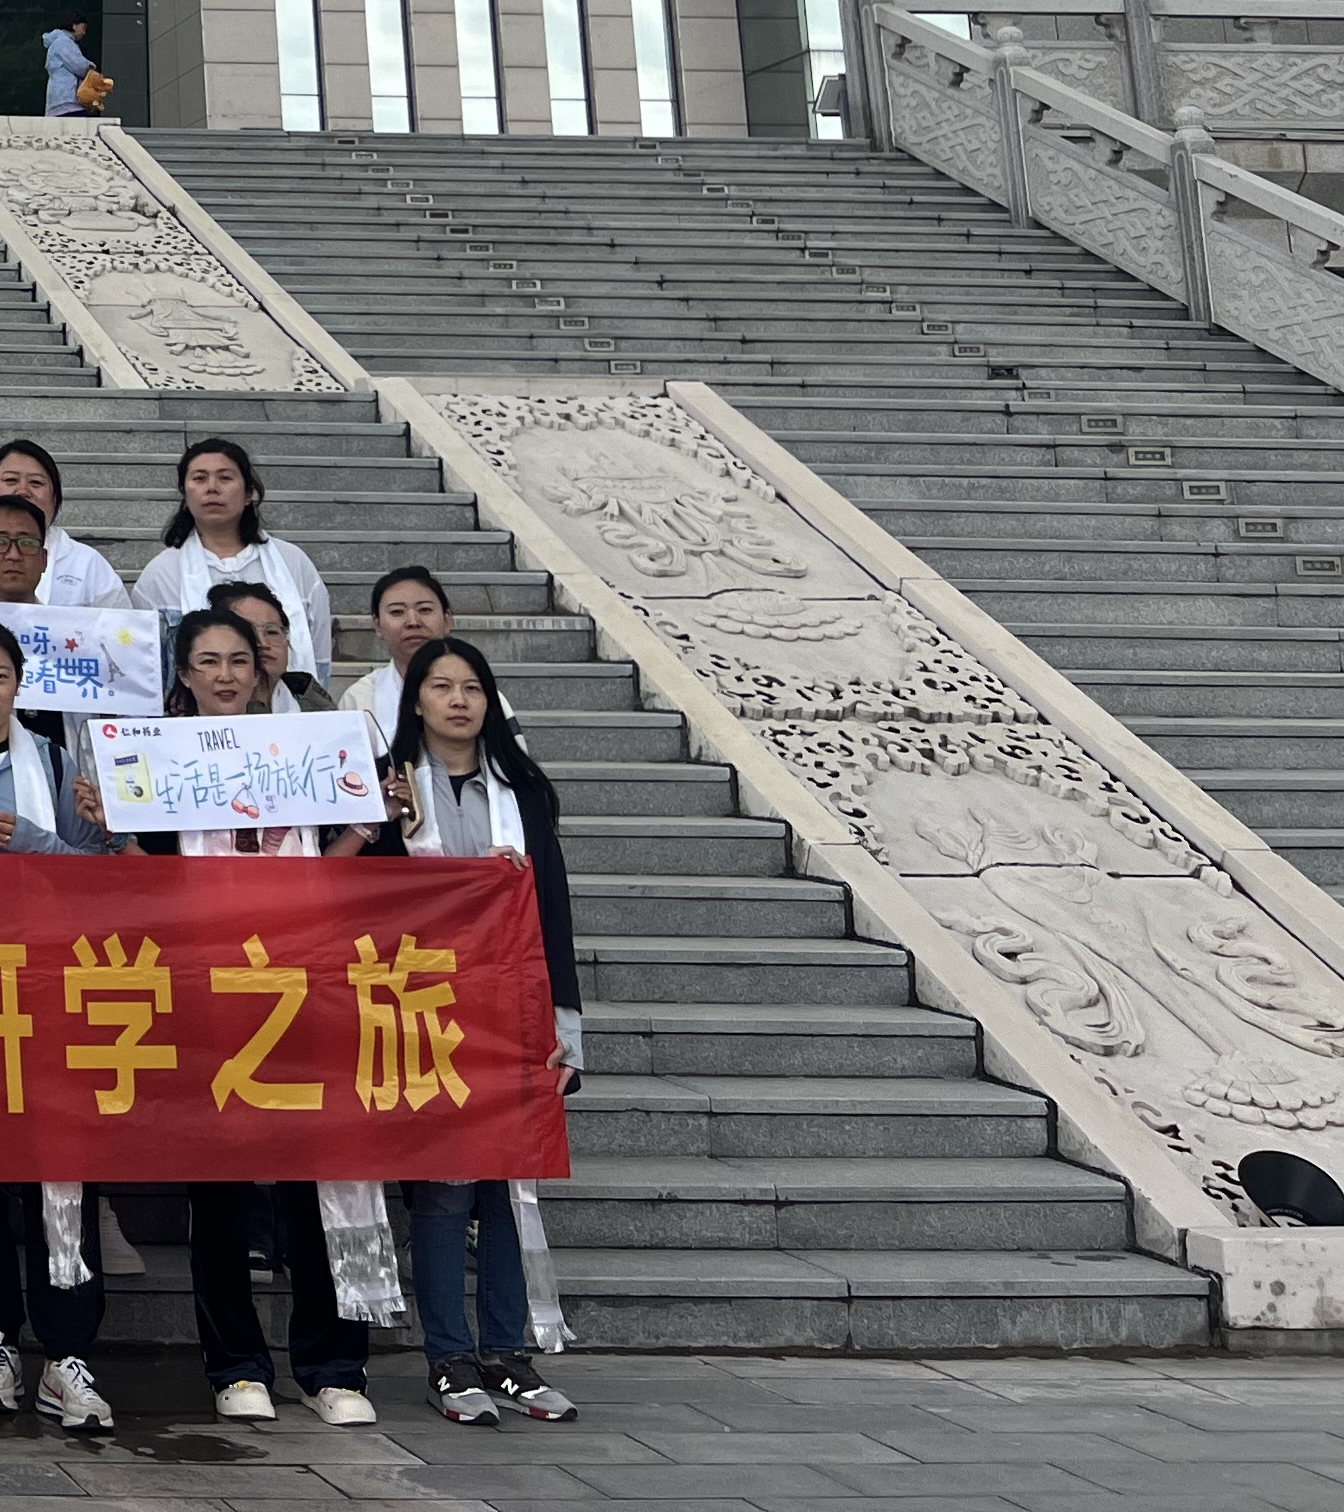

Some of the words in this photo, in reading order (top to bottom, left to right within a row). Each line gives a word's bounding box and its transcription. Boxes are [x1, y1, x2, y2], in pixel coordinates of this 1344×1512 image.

[121, 726, 163, 738] 仁和药业
[197, 727, 241, 753] TRAVEL
[155, 744, 338, 815] 生活是一场旅行
